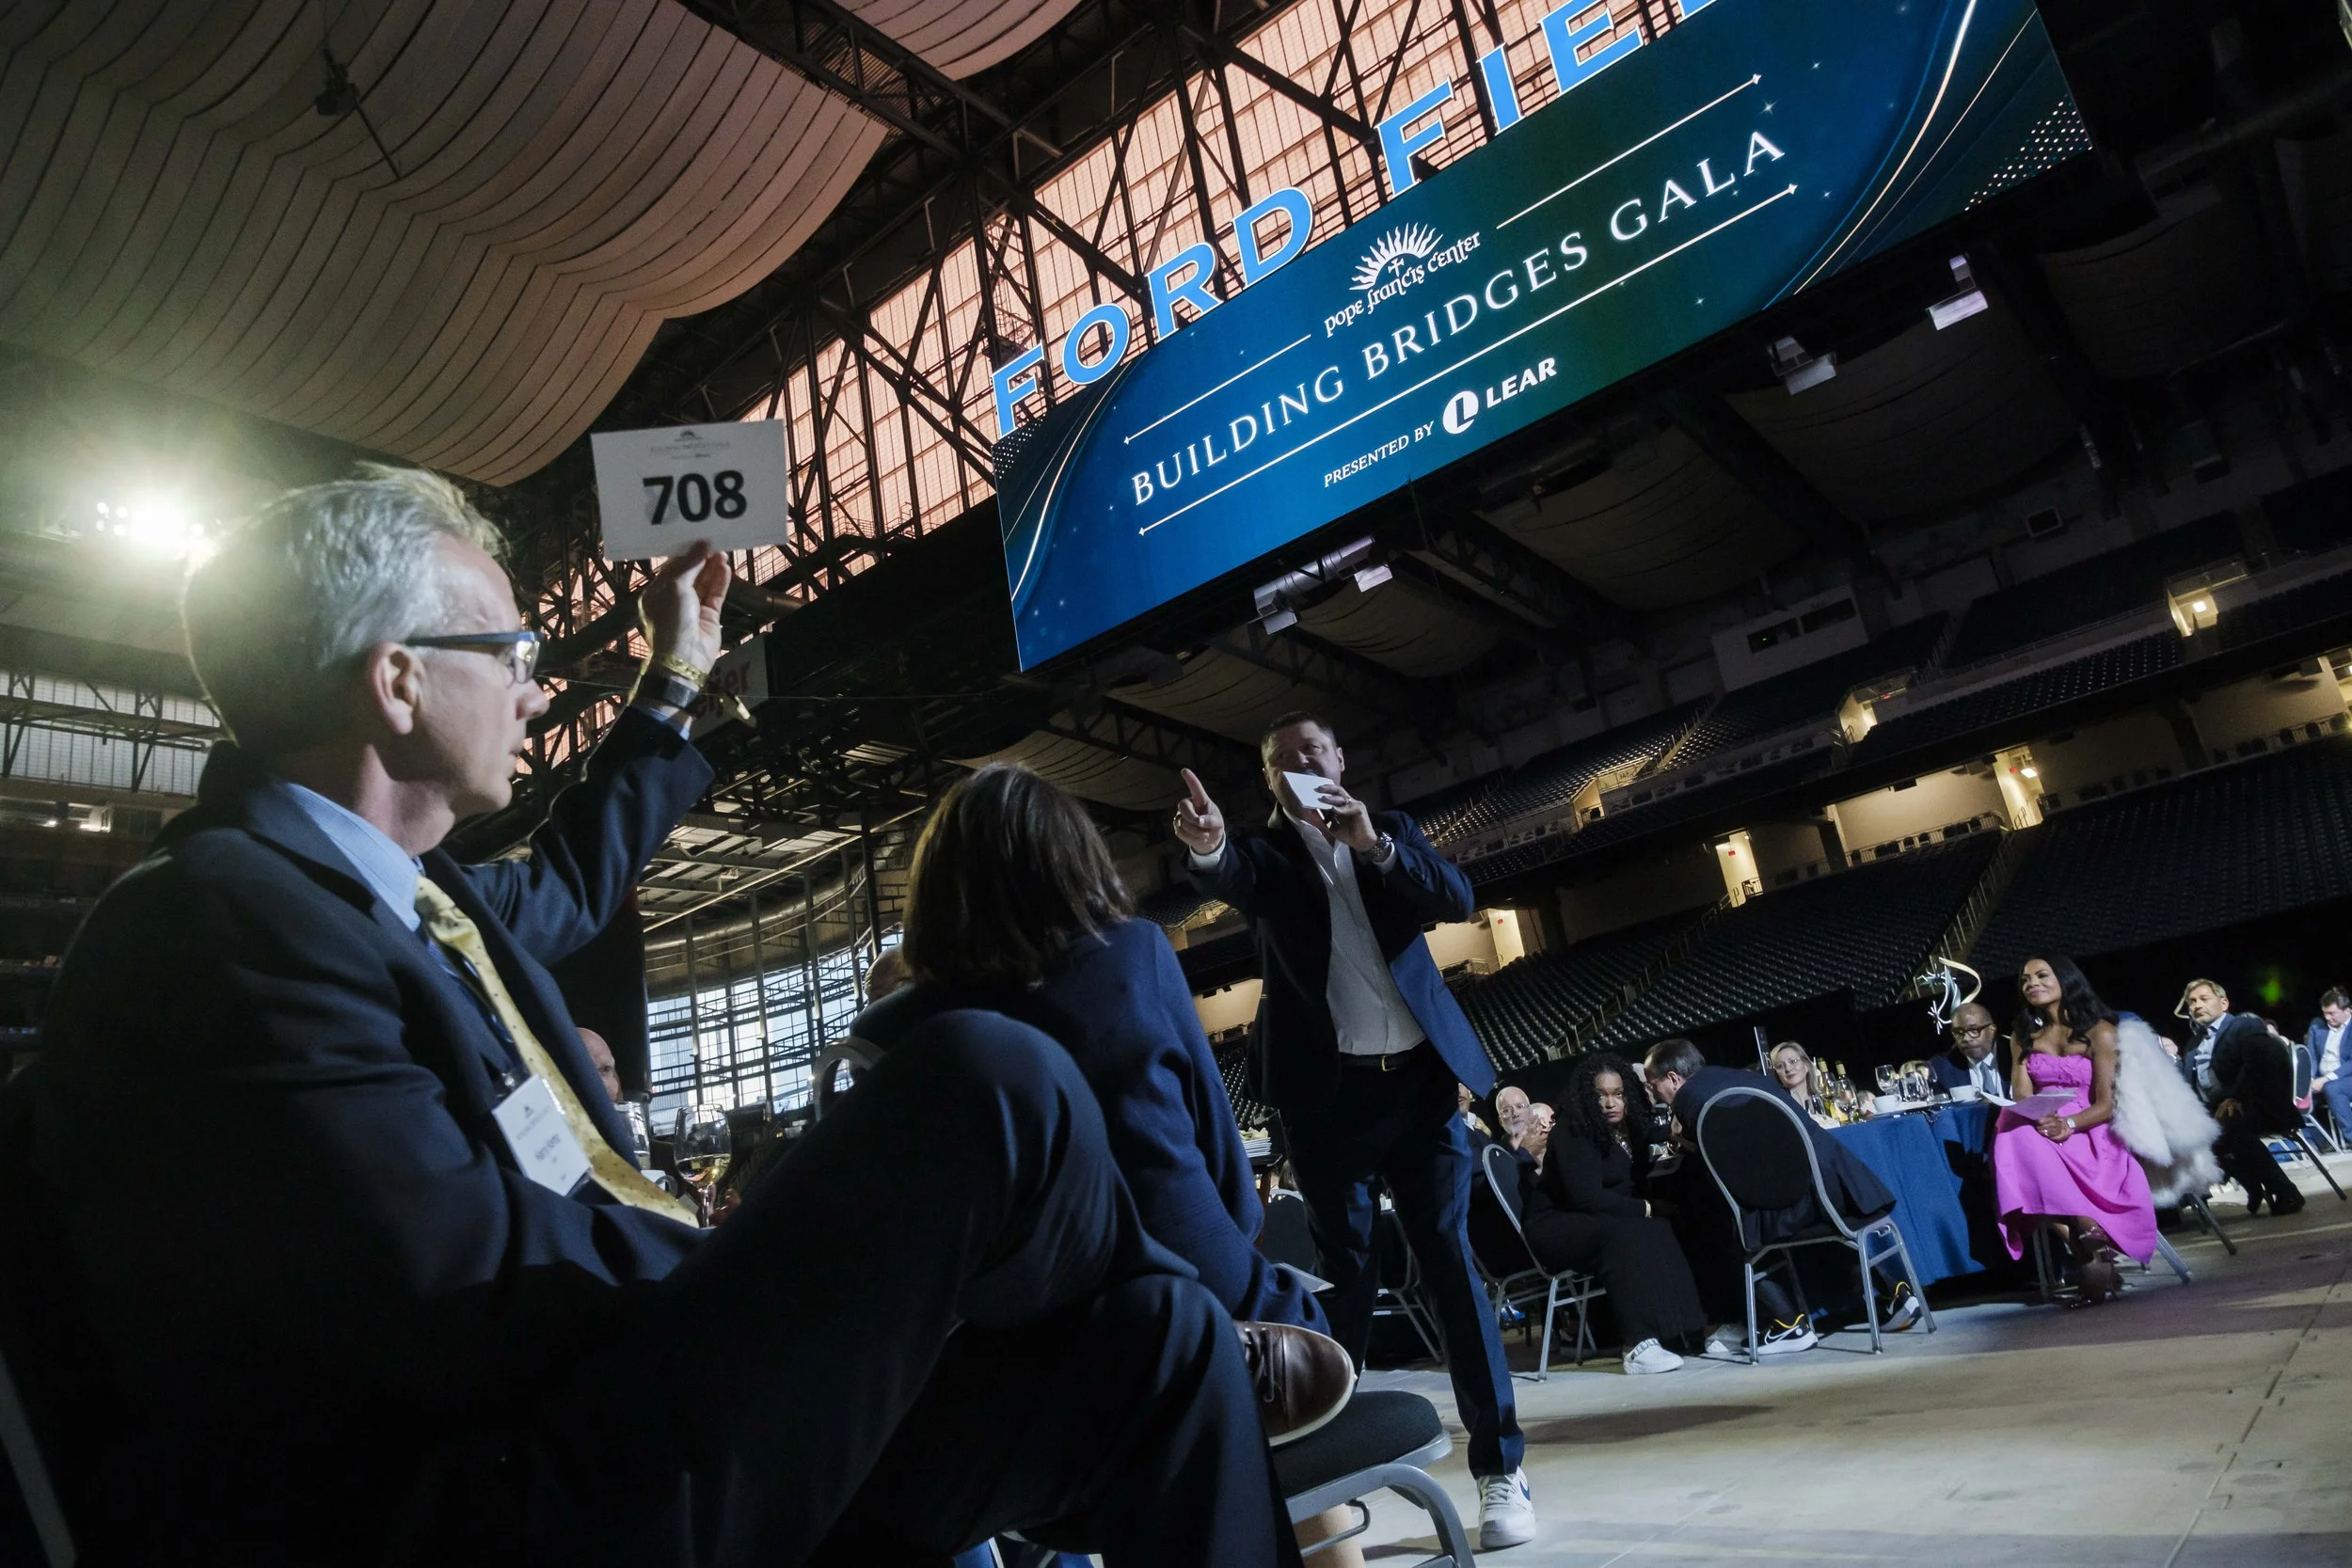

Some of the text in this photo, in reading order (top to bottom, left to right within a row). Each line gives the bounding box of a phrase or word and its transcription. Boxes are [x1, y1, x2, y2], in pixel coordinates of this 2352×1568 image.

[991, 0, 1717, 438] FORD FIE
[1324, 231, 1481, 338] pope francis center
[1131, 130, 1786, 506] BUILDING BRIDGES GALA
[1324, 435, 1409, 488] PRESENTED
[1414, 420, 1435, 443] BY
[1486, 357, 1557, 409] LEAR
[643, 469, 748, 526] 708
